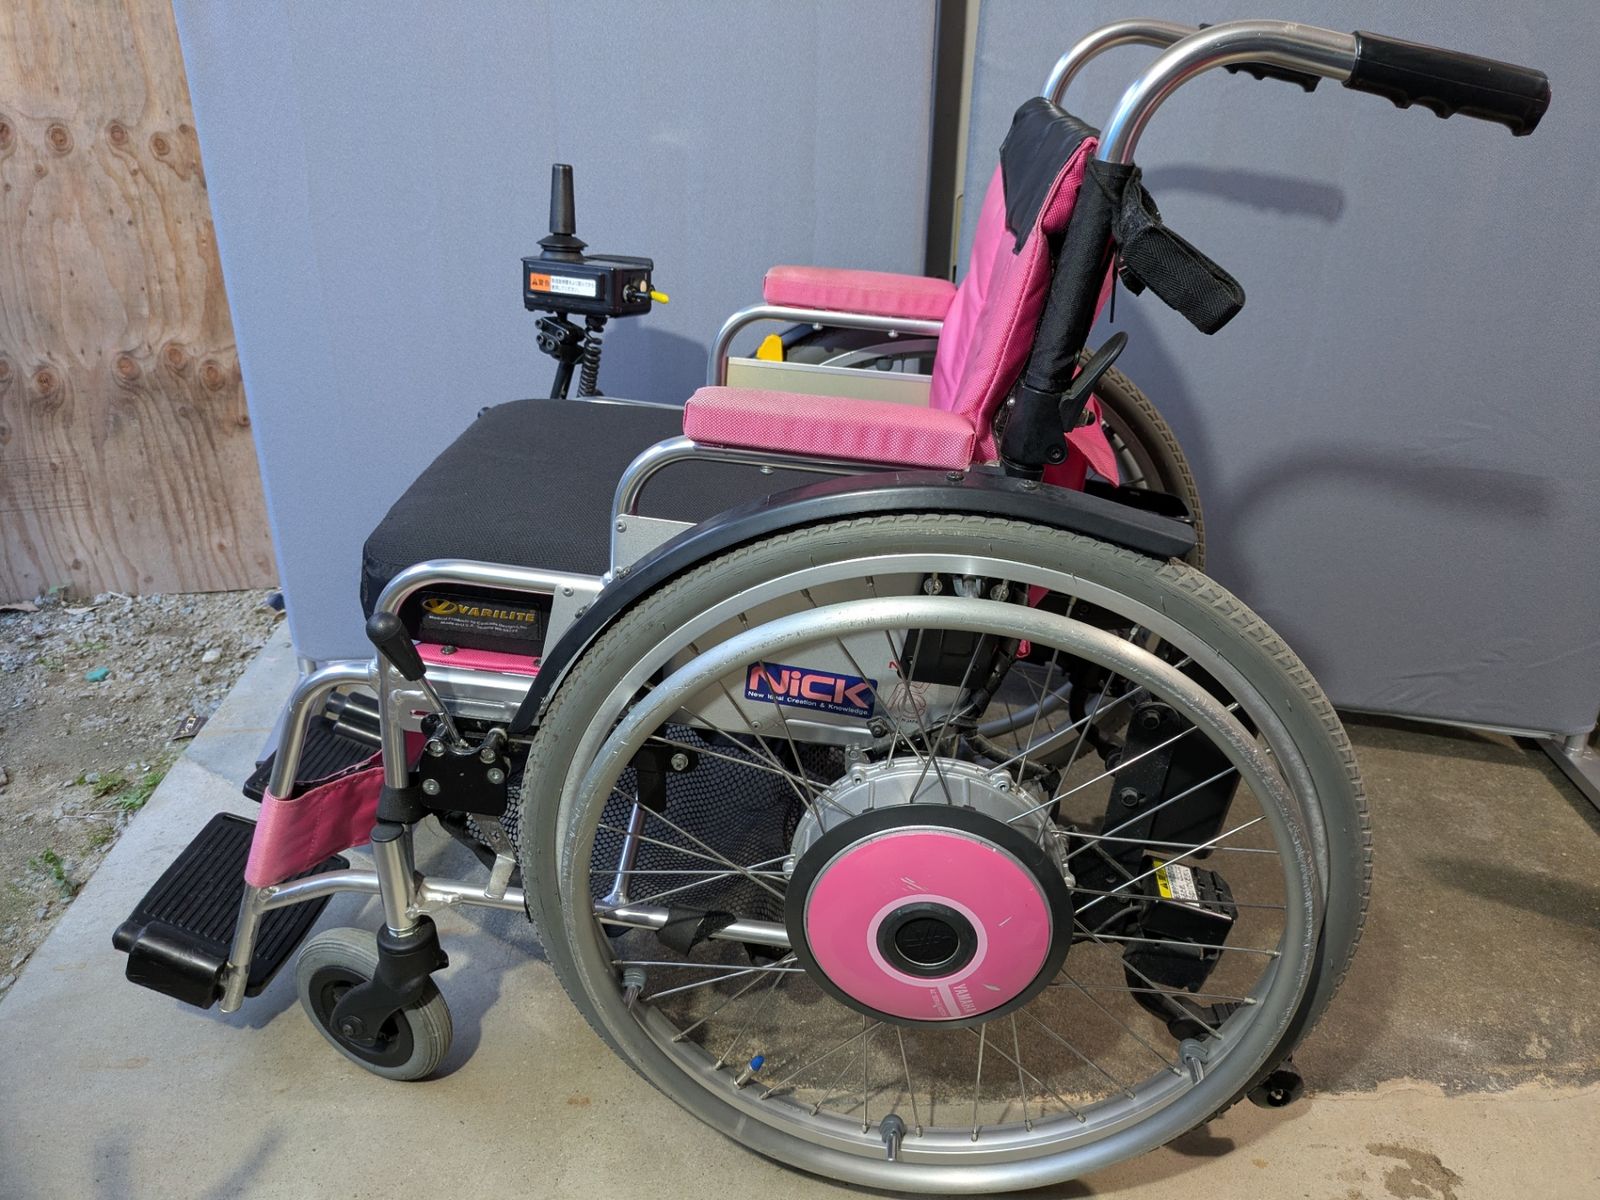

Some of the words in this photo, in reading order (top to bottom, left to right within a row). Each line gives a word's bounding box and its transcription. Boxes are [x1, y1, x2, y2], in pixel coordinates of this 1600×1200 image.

[458, 603, 535, 622] VARILITE
[787, 696, 817, 706] Creation
[953, 983, 977, 1012] YAMAHA
